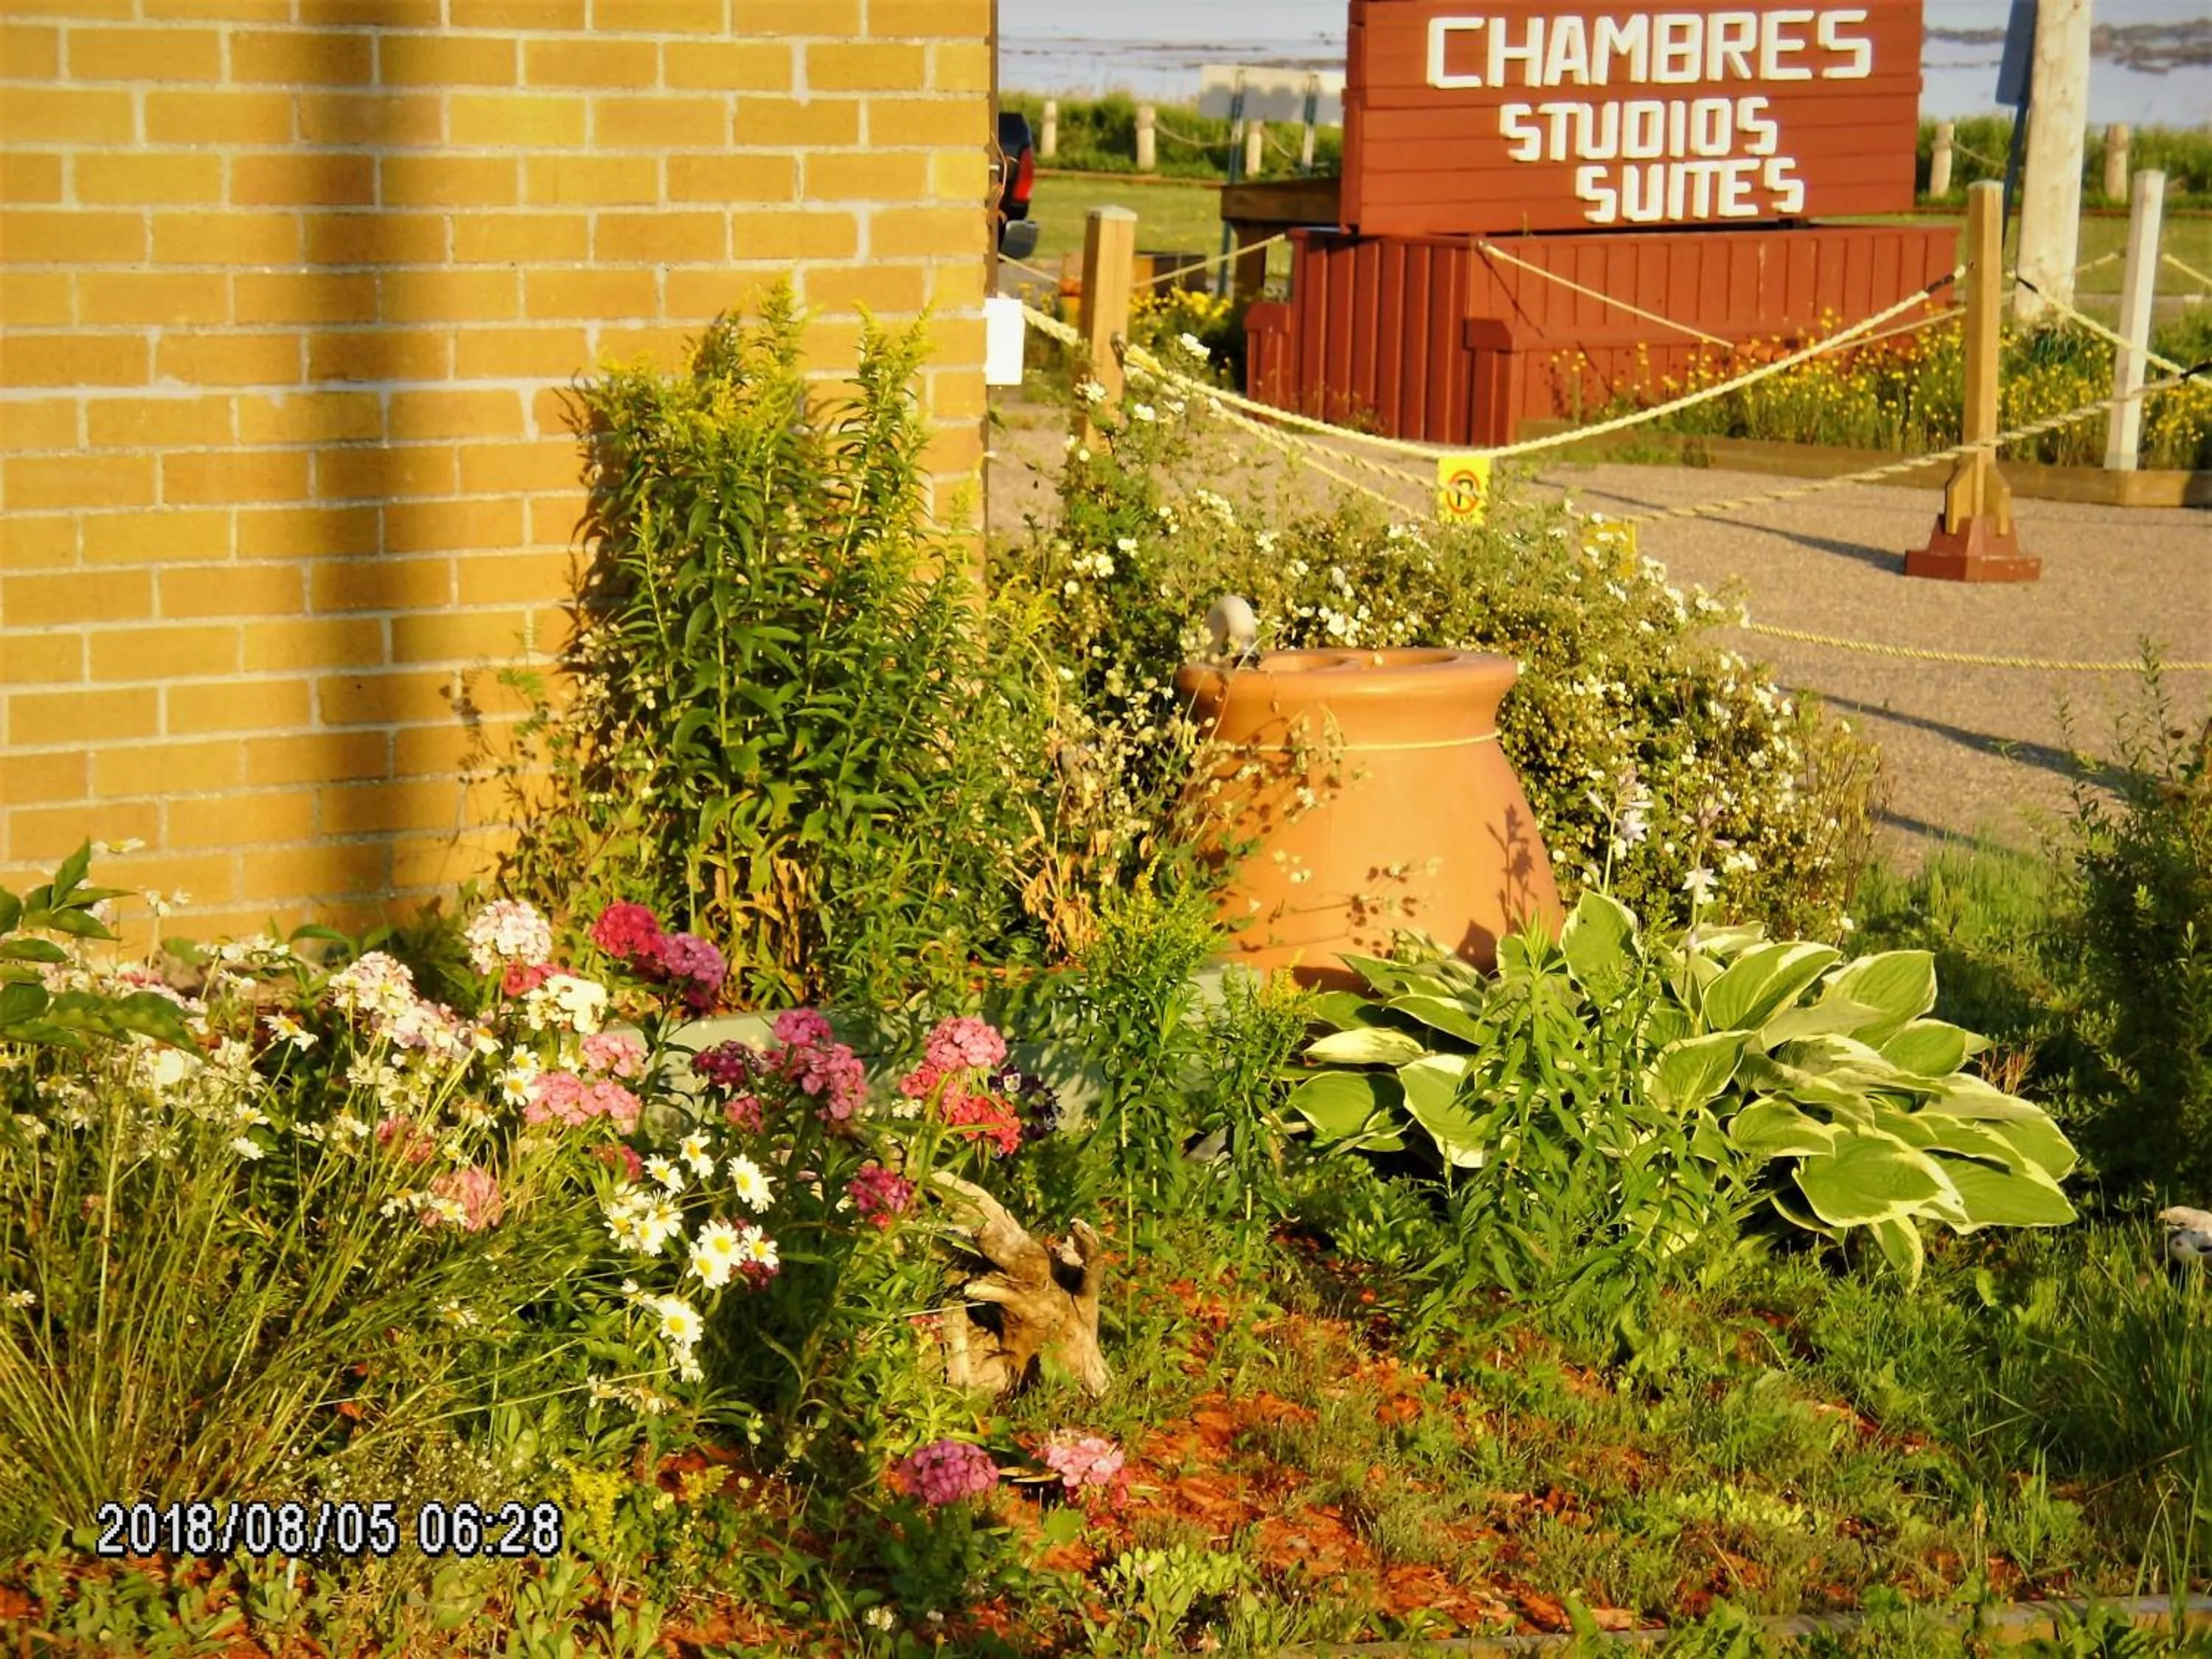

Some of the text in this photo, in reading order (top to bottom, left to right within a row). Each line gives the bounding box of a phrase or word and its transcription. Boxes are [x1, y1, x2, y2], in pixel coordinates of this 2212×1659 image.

[1427, 10, 1872, 88] CHAMBRES
[1499, 96, 1778, 161] STUDIOS
[1575, 156, 1805, 223] SUITES
